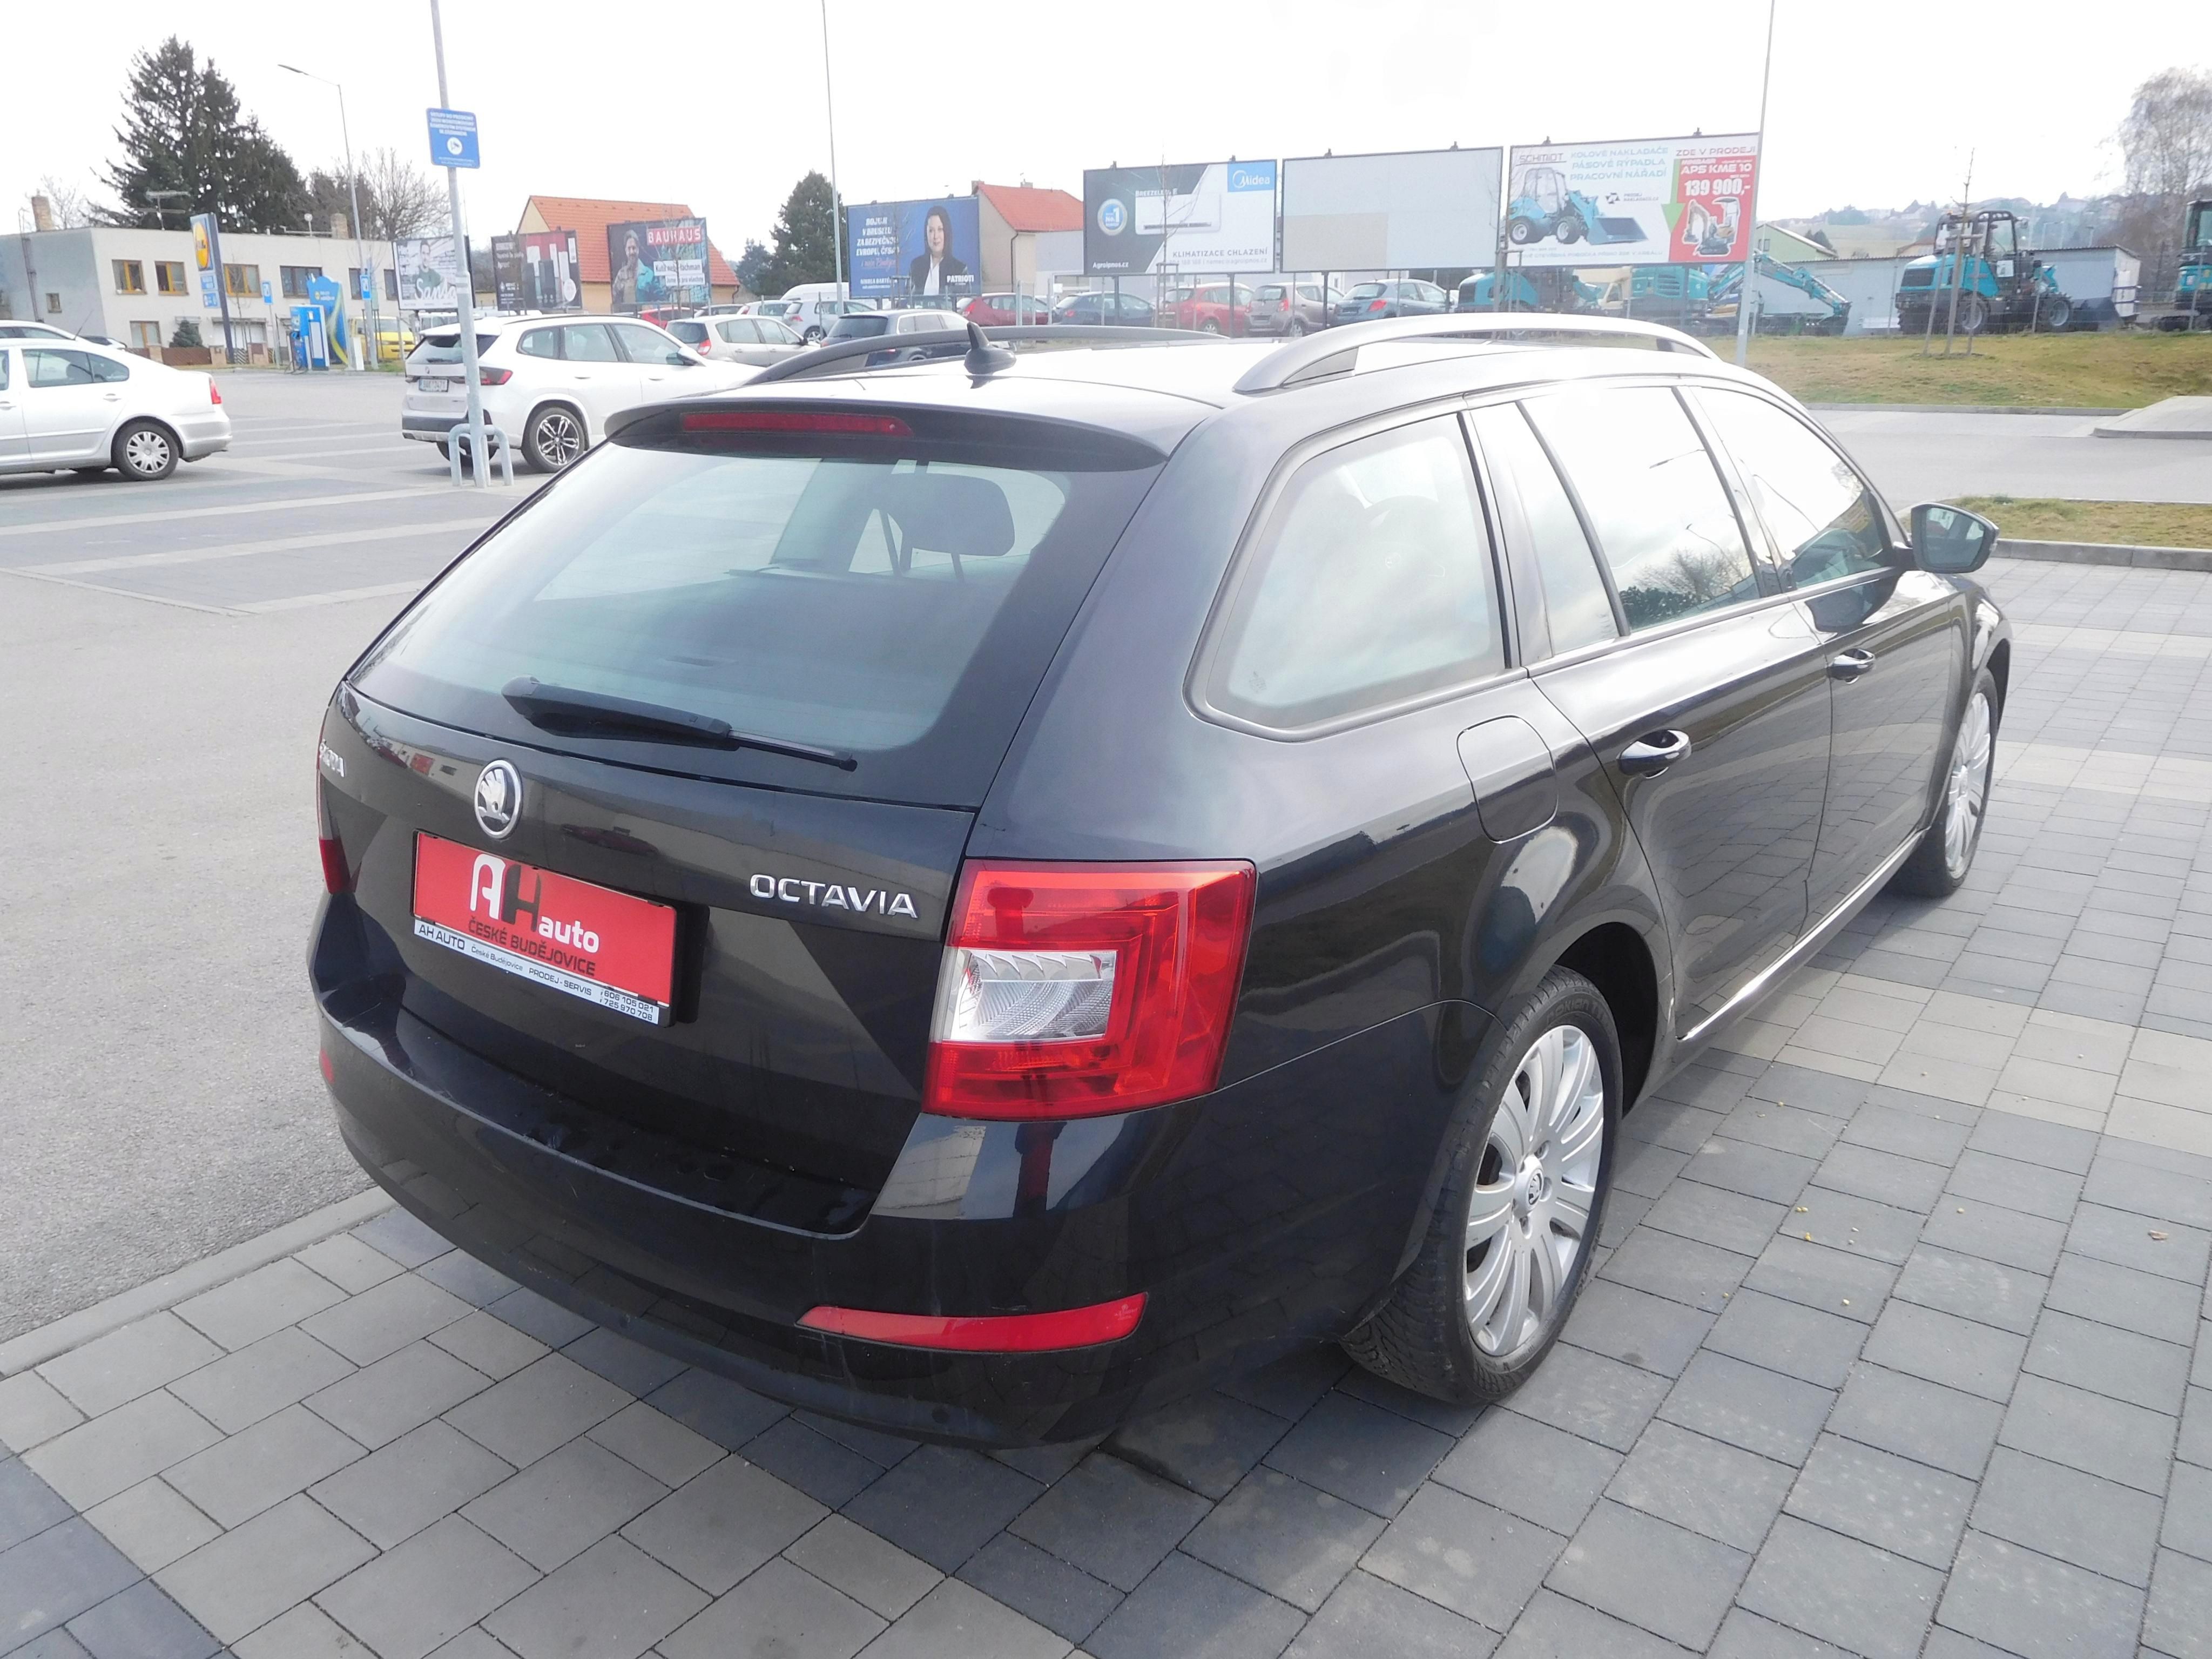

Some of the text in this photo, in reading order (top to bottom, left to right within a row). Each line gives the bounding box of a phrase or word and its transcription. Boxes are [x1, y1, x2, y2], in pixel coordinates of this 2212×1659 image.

[1710, 146, 1755, 155] PRODEJI
[1681, 163, 1752, 174] APS KME 10
[1684, 178, 1751, 196] 139 900,-
[648, 228, 701, 244] BAUHAUS
[1227, 247, 1267, 256] CHLAZENÍ
[947, 275, 974, 283] PATRIOTI
[750, 874, 918, 919] OCTAVIA
[538, 916, 599, 954] auto
[419, 924, 434, 938] AH
[435, 931, 465, 950] AUTO
[471, 944, 489, 959] České
[490, 953, 523, 971] Budějovice
[468, 916, 596, 976] ČESKÉ BUDĚJOVICE
[604, 990, 653, 1013] 606 105 021
[604, 998, 652, 1021] 725 970 708
